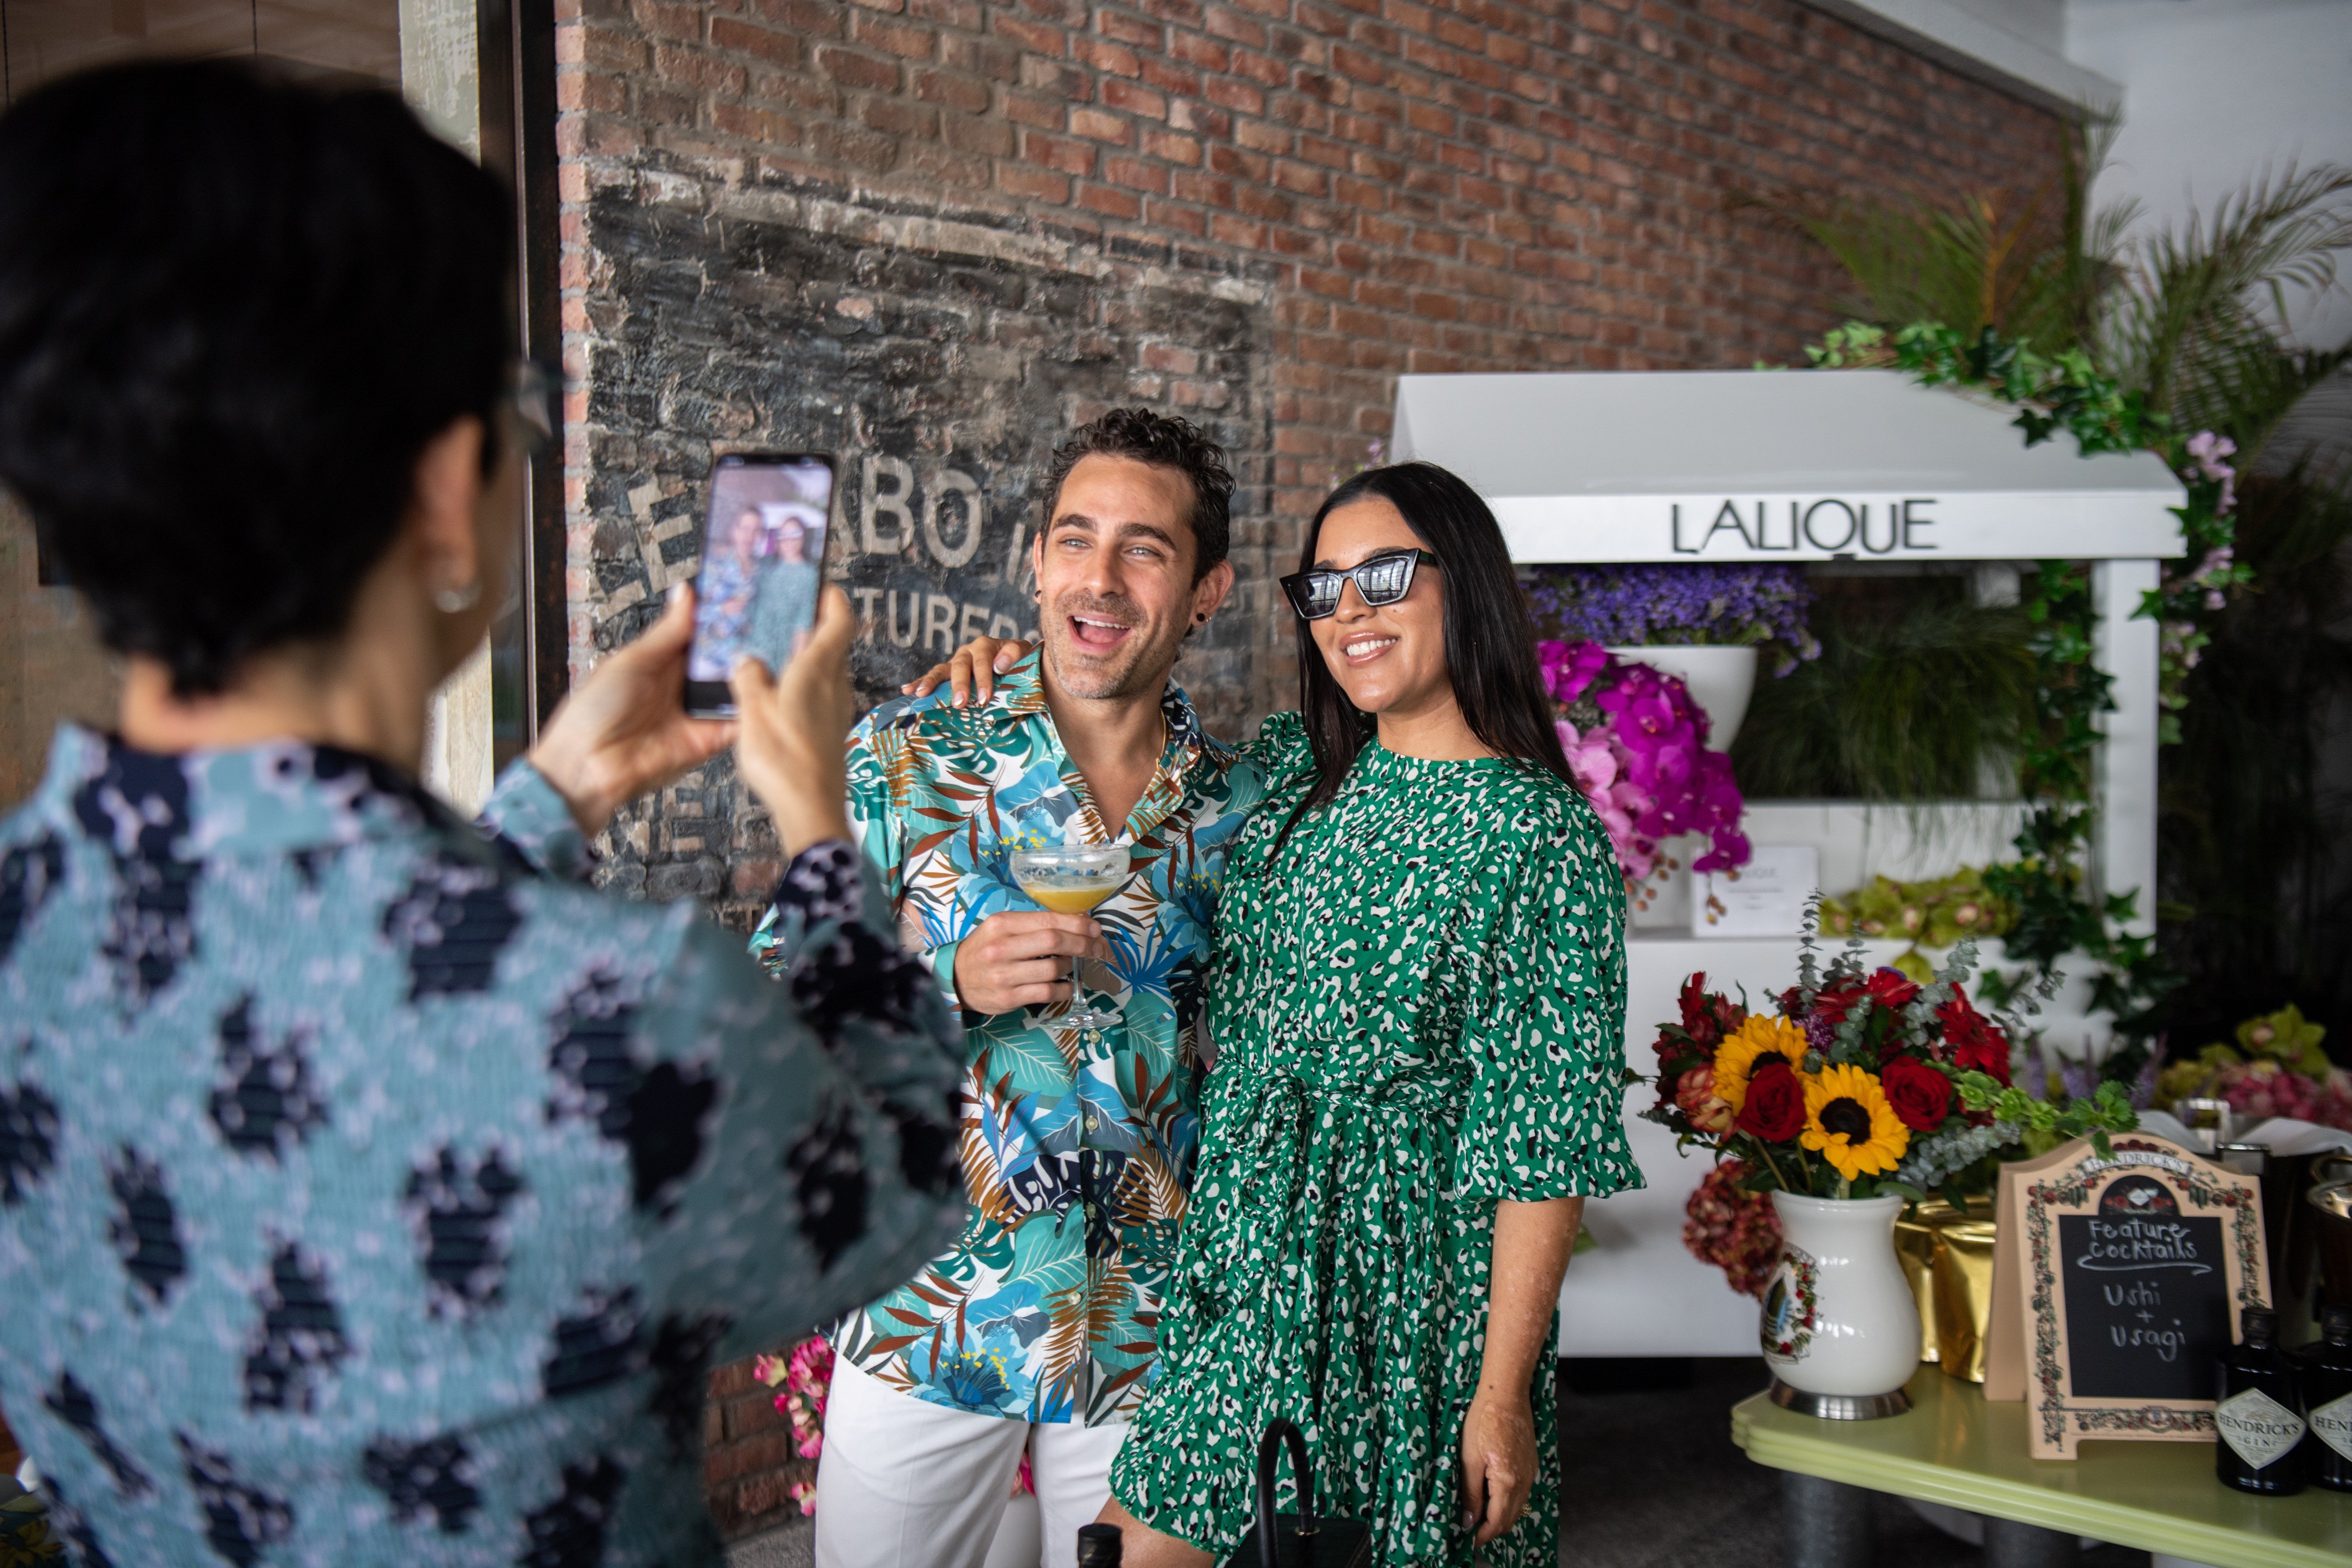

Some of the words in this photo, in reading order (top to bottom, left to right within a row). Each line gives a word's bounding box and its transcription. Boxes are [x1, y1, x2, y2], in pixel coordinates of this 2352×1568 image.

[1671, 499, 1939, 554] LALIQUE
[2091, 1153, 2184, 1171] HDRICK'S
[2088, 1219, 2191, 1240] Feature
[2104, 1281, 2161, 1306] Ushi
[2110, 1318, 2187, 1362] Usagi
[2219, 1413, 2299, 1435] HENDRICK'S
[2315, 1416, 2352, 1431] HEN
[2244, 1437, 2271, 1447] GIN
